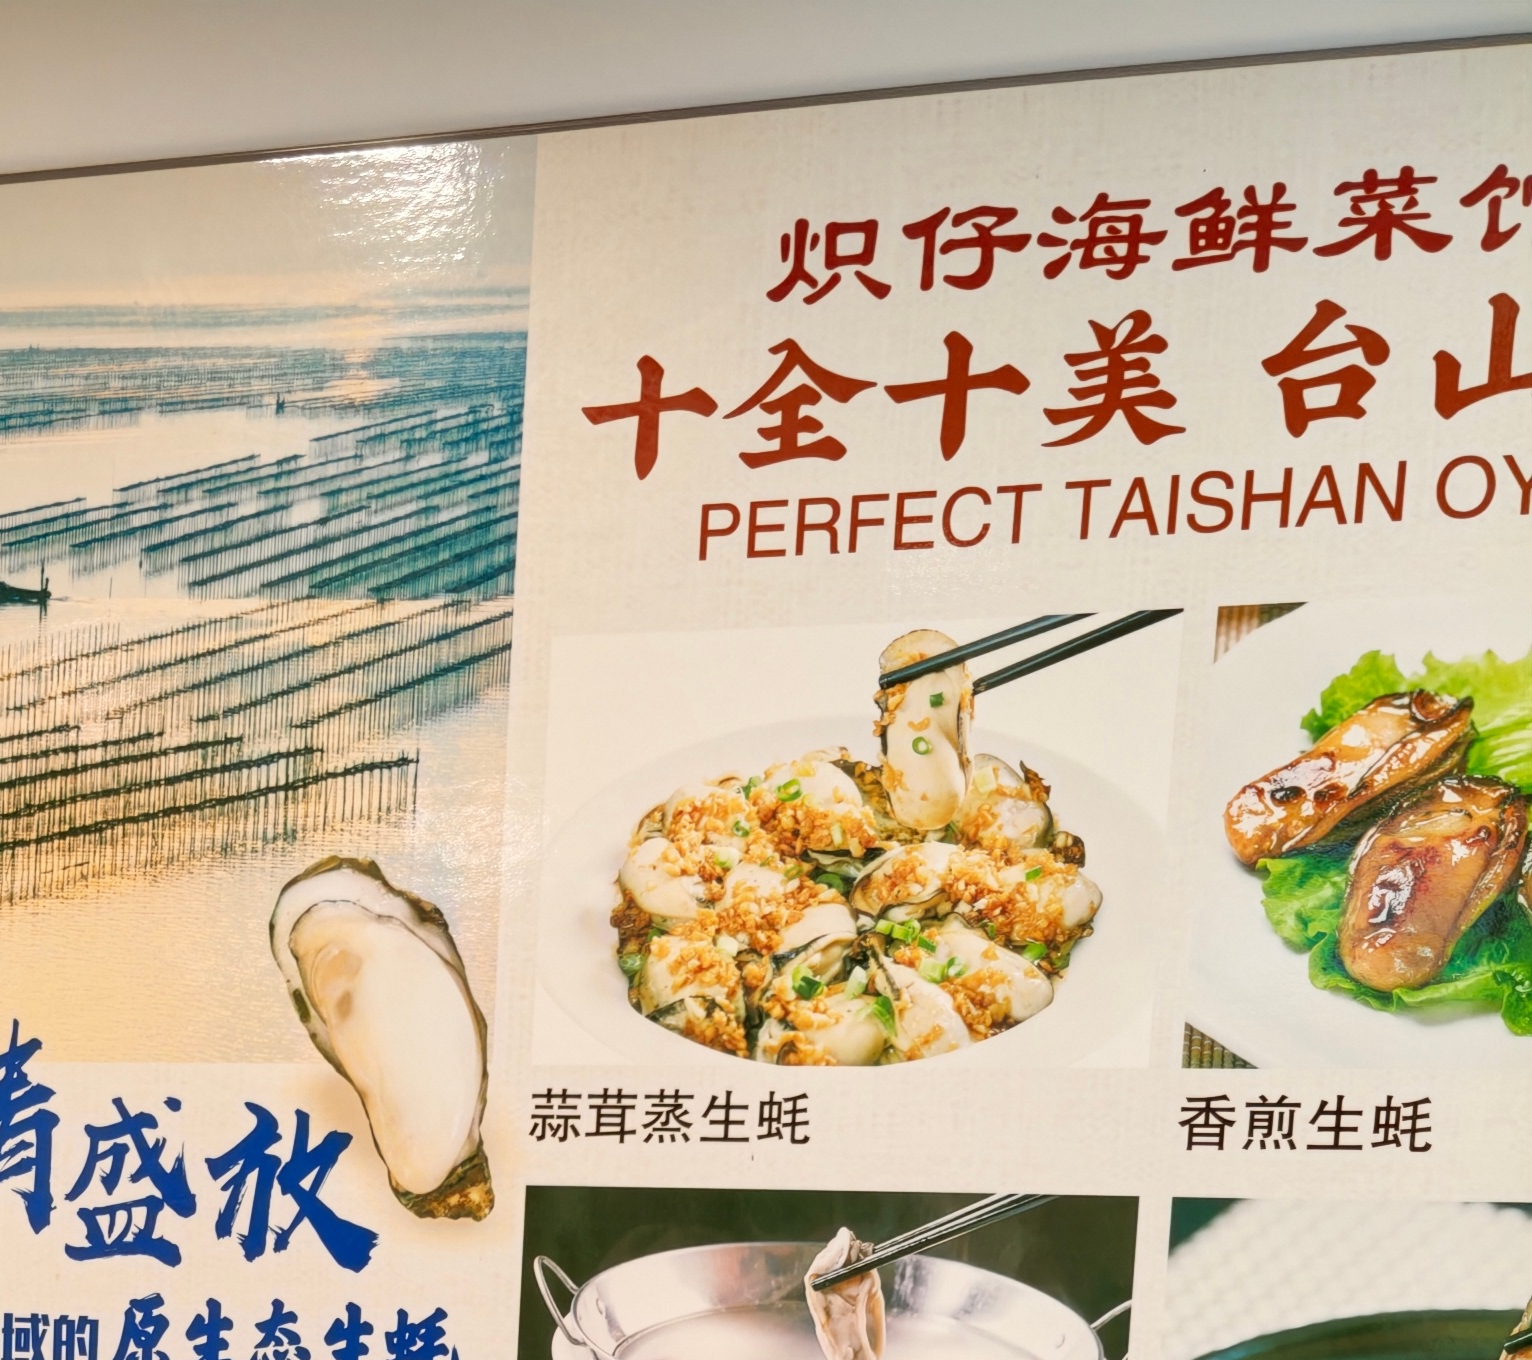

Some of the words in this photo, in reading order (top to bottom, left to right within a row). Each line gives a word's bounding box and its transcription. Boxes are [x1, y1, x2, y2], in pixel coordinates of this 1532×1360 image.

[581, 309, 1186, 480] 十全十美
[698, 483, 1044, 561] PERFECT
[1065, 460, 1407, 540] TAISHAN
[528, 1088, 811, 1146] 蒜茸蒸生蚝
[1178, 1094, 1434, 1153] 香煎生蚝
